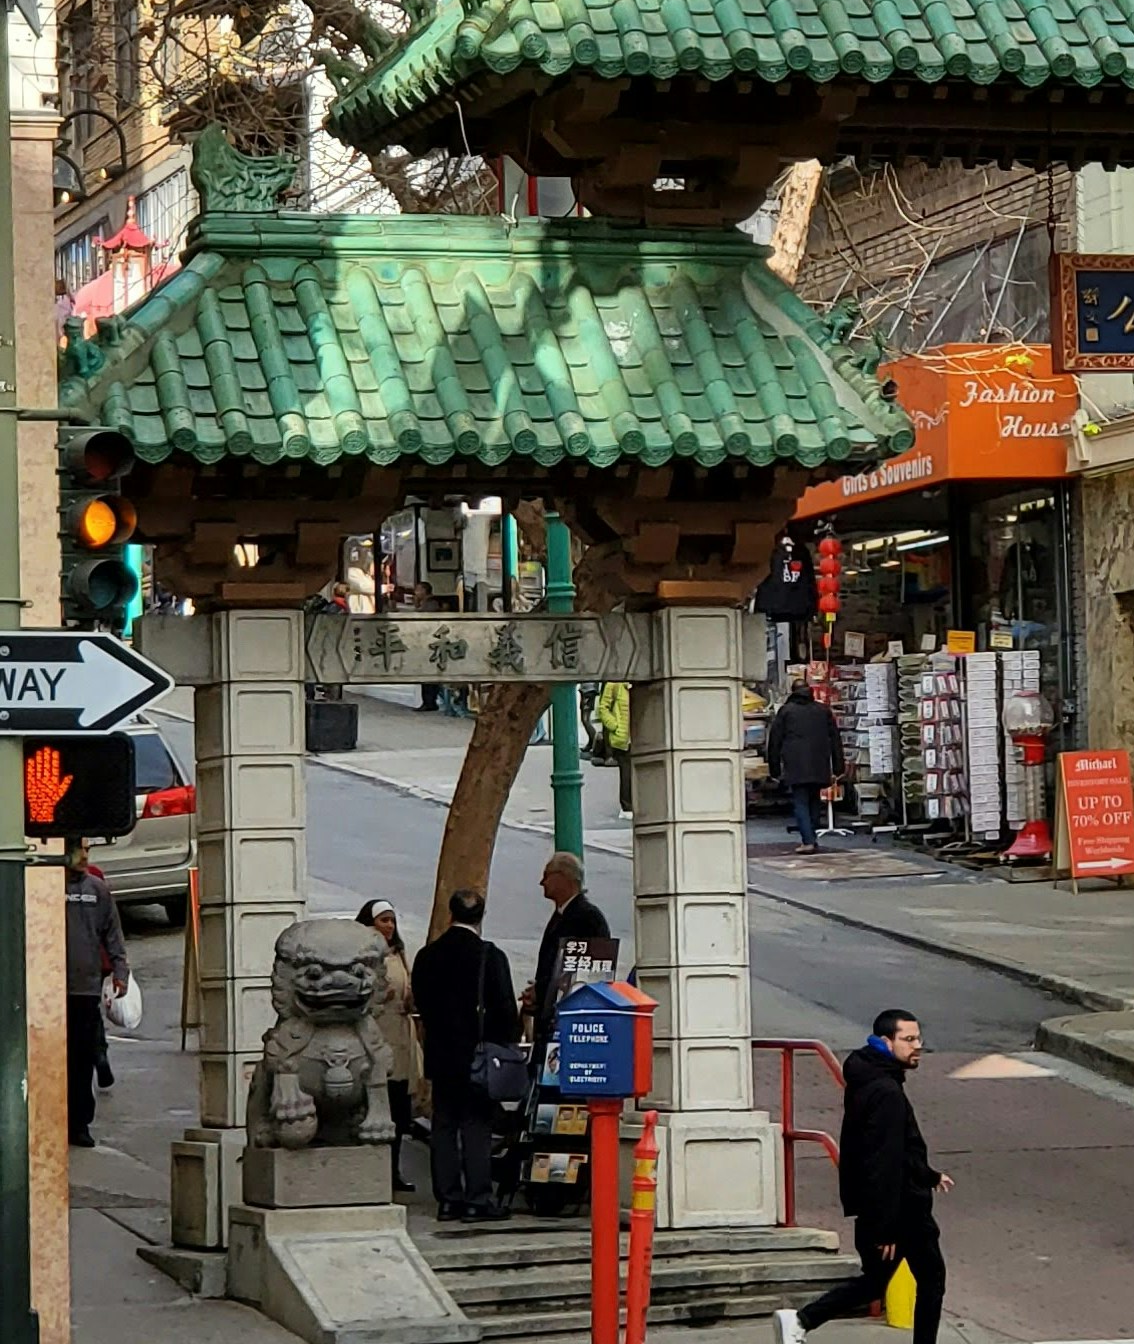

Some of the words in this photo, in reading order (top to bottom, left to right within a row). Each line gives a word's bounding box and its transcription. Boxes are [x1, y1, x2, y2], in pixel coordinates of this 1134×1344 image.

[960, 381, 1056, 407] Fashion
[879, 452, 933, 487] Souvenirs
[1075, 757, 1117, 772] Michael
[1078, 796, 1099, 810] UP
[1101, 794, 1122, 809] TO
[1072, 814, 1099, 828] 70%
[1102, 811, 1132, 826] OFF
[566, 941, 588, 954] 学习
[572, 1023, 605, 1033] POLICE
[569, 1035, 609, 1043] TELEPHONE
